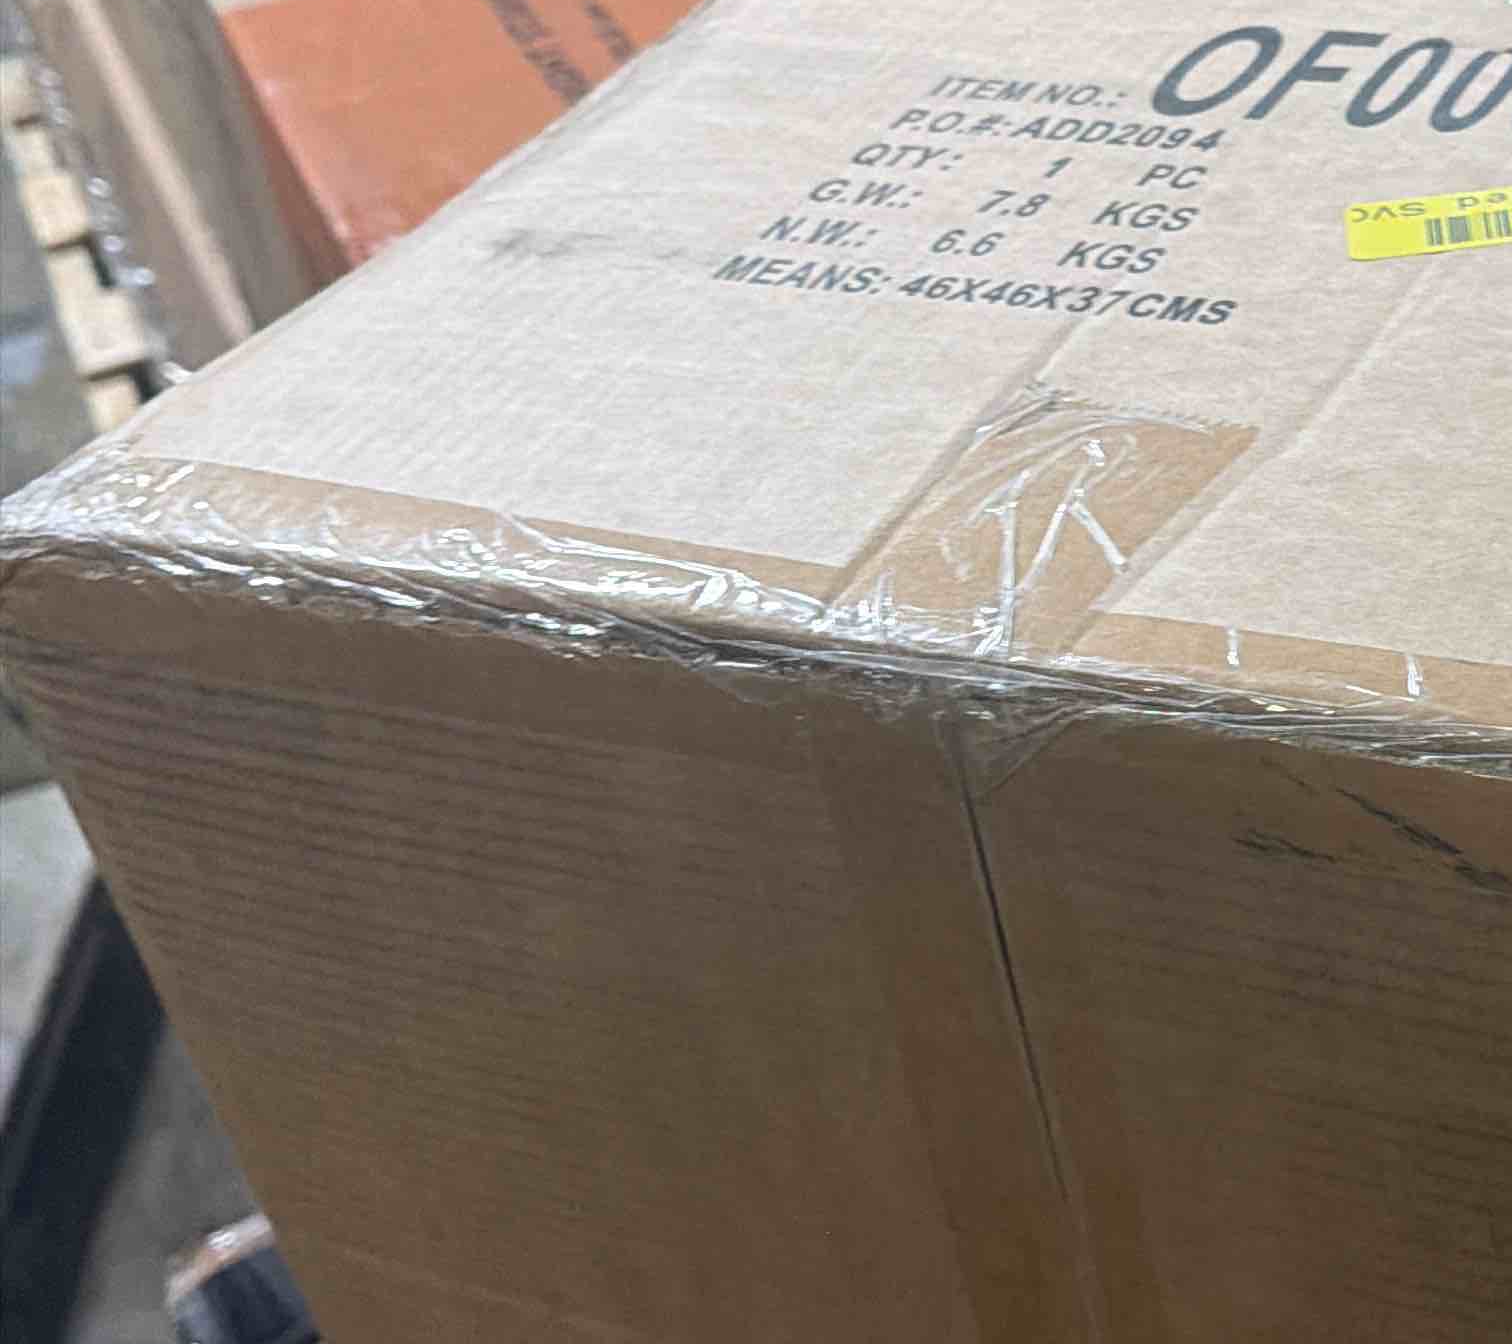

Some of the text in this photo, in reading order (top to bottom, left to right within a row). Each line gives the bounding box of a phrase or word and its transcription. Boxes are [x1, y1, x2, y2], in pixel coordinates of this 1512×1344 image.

[929, 75, 1031, 102] ITEM
[852, 142, 1209, 190] QTY: 1 PC
[976, 190, 1052, 217] 7.8
[1090, 200, 1202, 232] KGS
[1351, 201, 1426, 224] SVC
[930, 229, 1005, 257] 6.6
[1056, 241, 1167, 274] KGS
[713, 255, 894, 296] MEANS:
